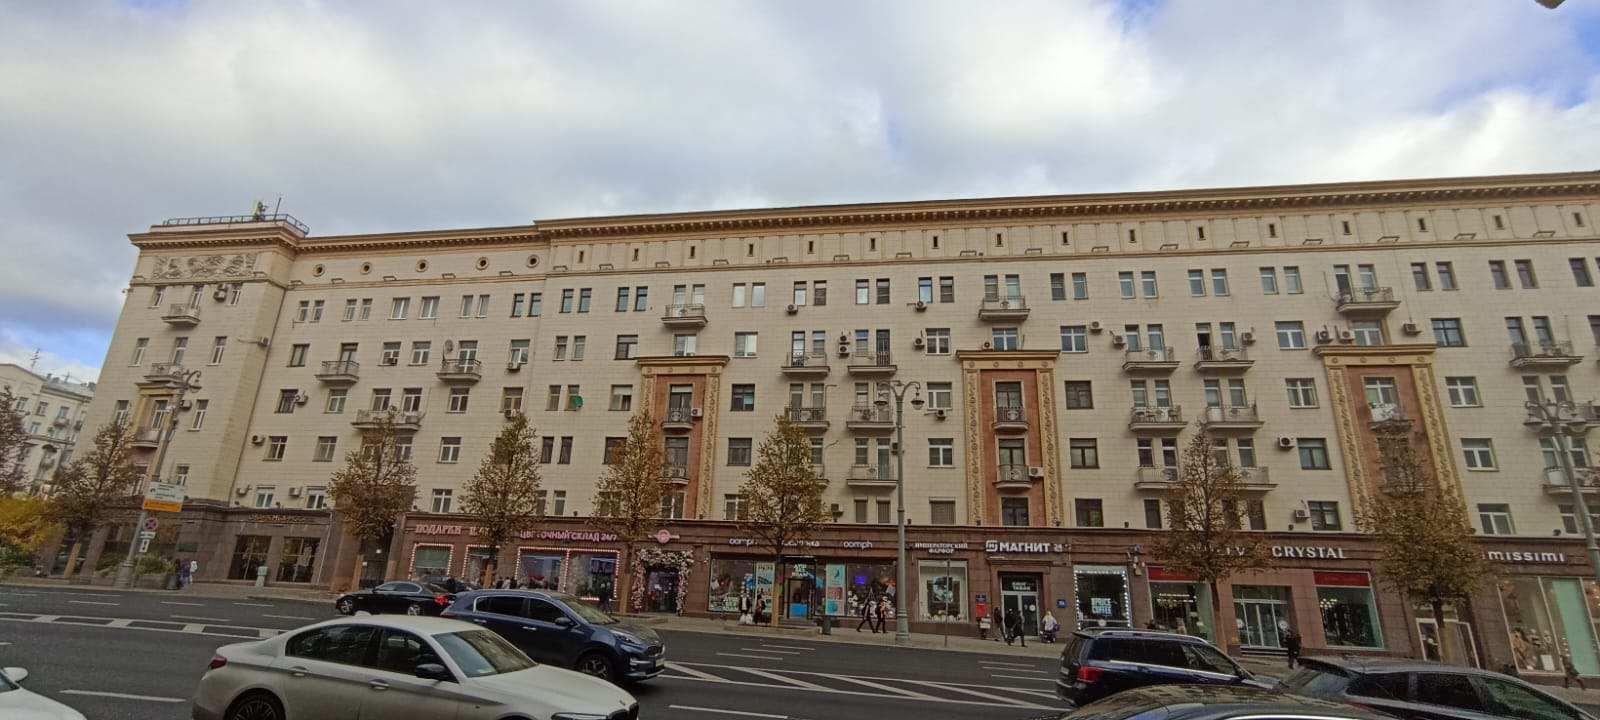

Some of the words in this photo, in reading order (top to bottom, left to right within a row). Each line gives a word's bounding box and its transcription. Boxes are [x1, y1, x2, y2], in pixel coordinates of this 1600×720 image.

[415, 524, 462, 536] ПОДАРКИ
[519, 530, 568, 540] ЦВЕОЧНЫЙ
[570, 532, 600, 542] СКЛАД
[601, 533, 617, 541] 24/7
[843, 540, 872, 550] oomph
[1000, 542, 1050, 553] МАГНИТ
[1271, 545, 1347, 559] CRYSTAL
